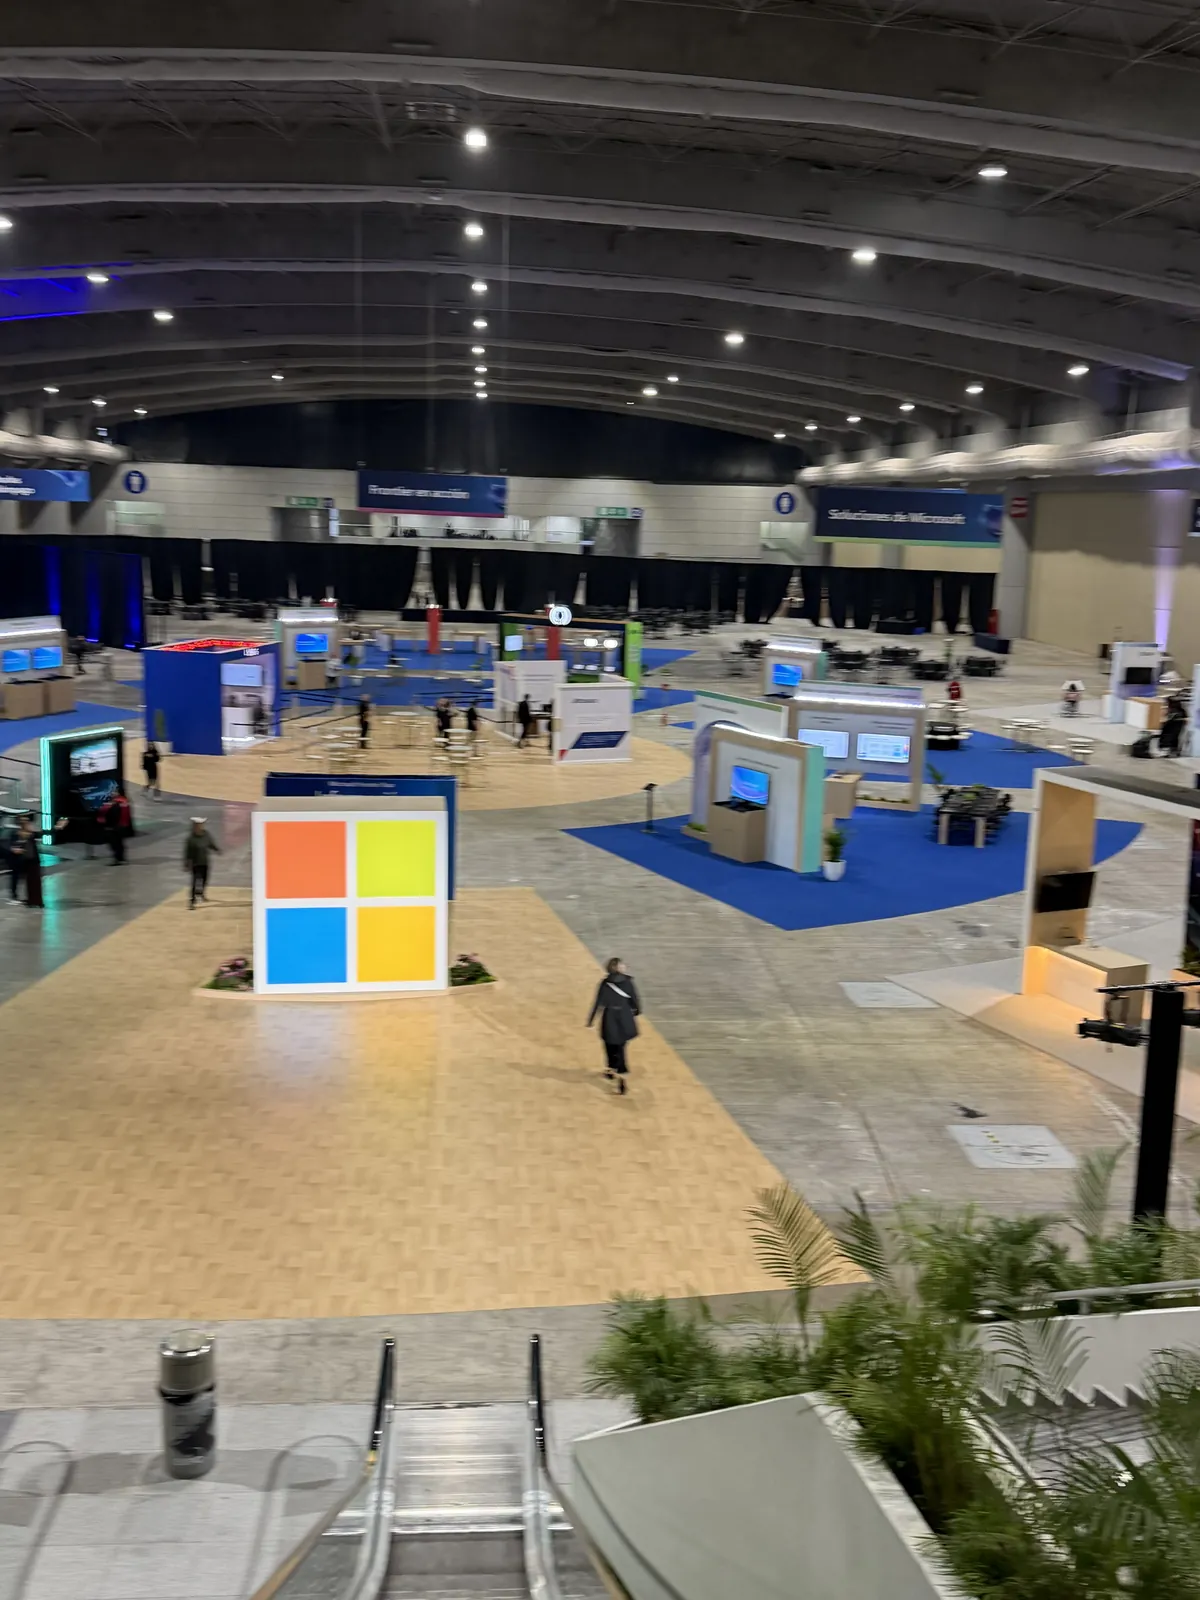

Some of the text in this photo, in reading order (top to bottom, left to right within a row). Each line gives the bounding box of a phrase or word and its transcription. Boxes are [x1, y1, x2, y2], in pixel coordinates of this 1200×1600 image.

[828, 509, 966, 524] Soluciones de Microsoft
